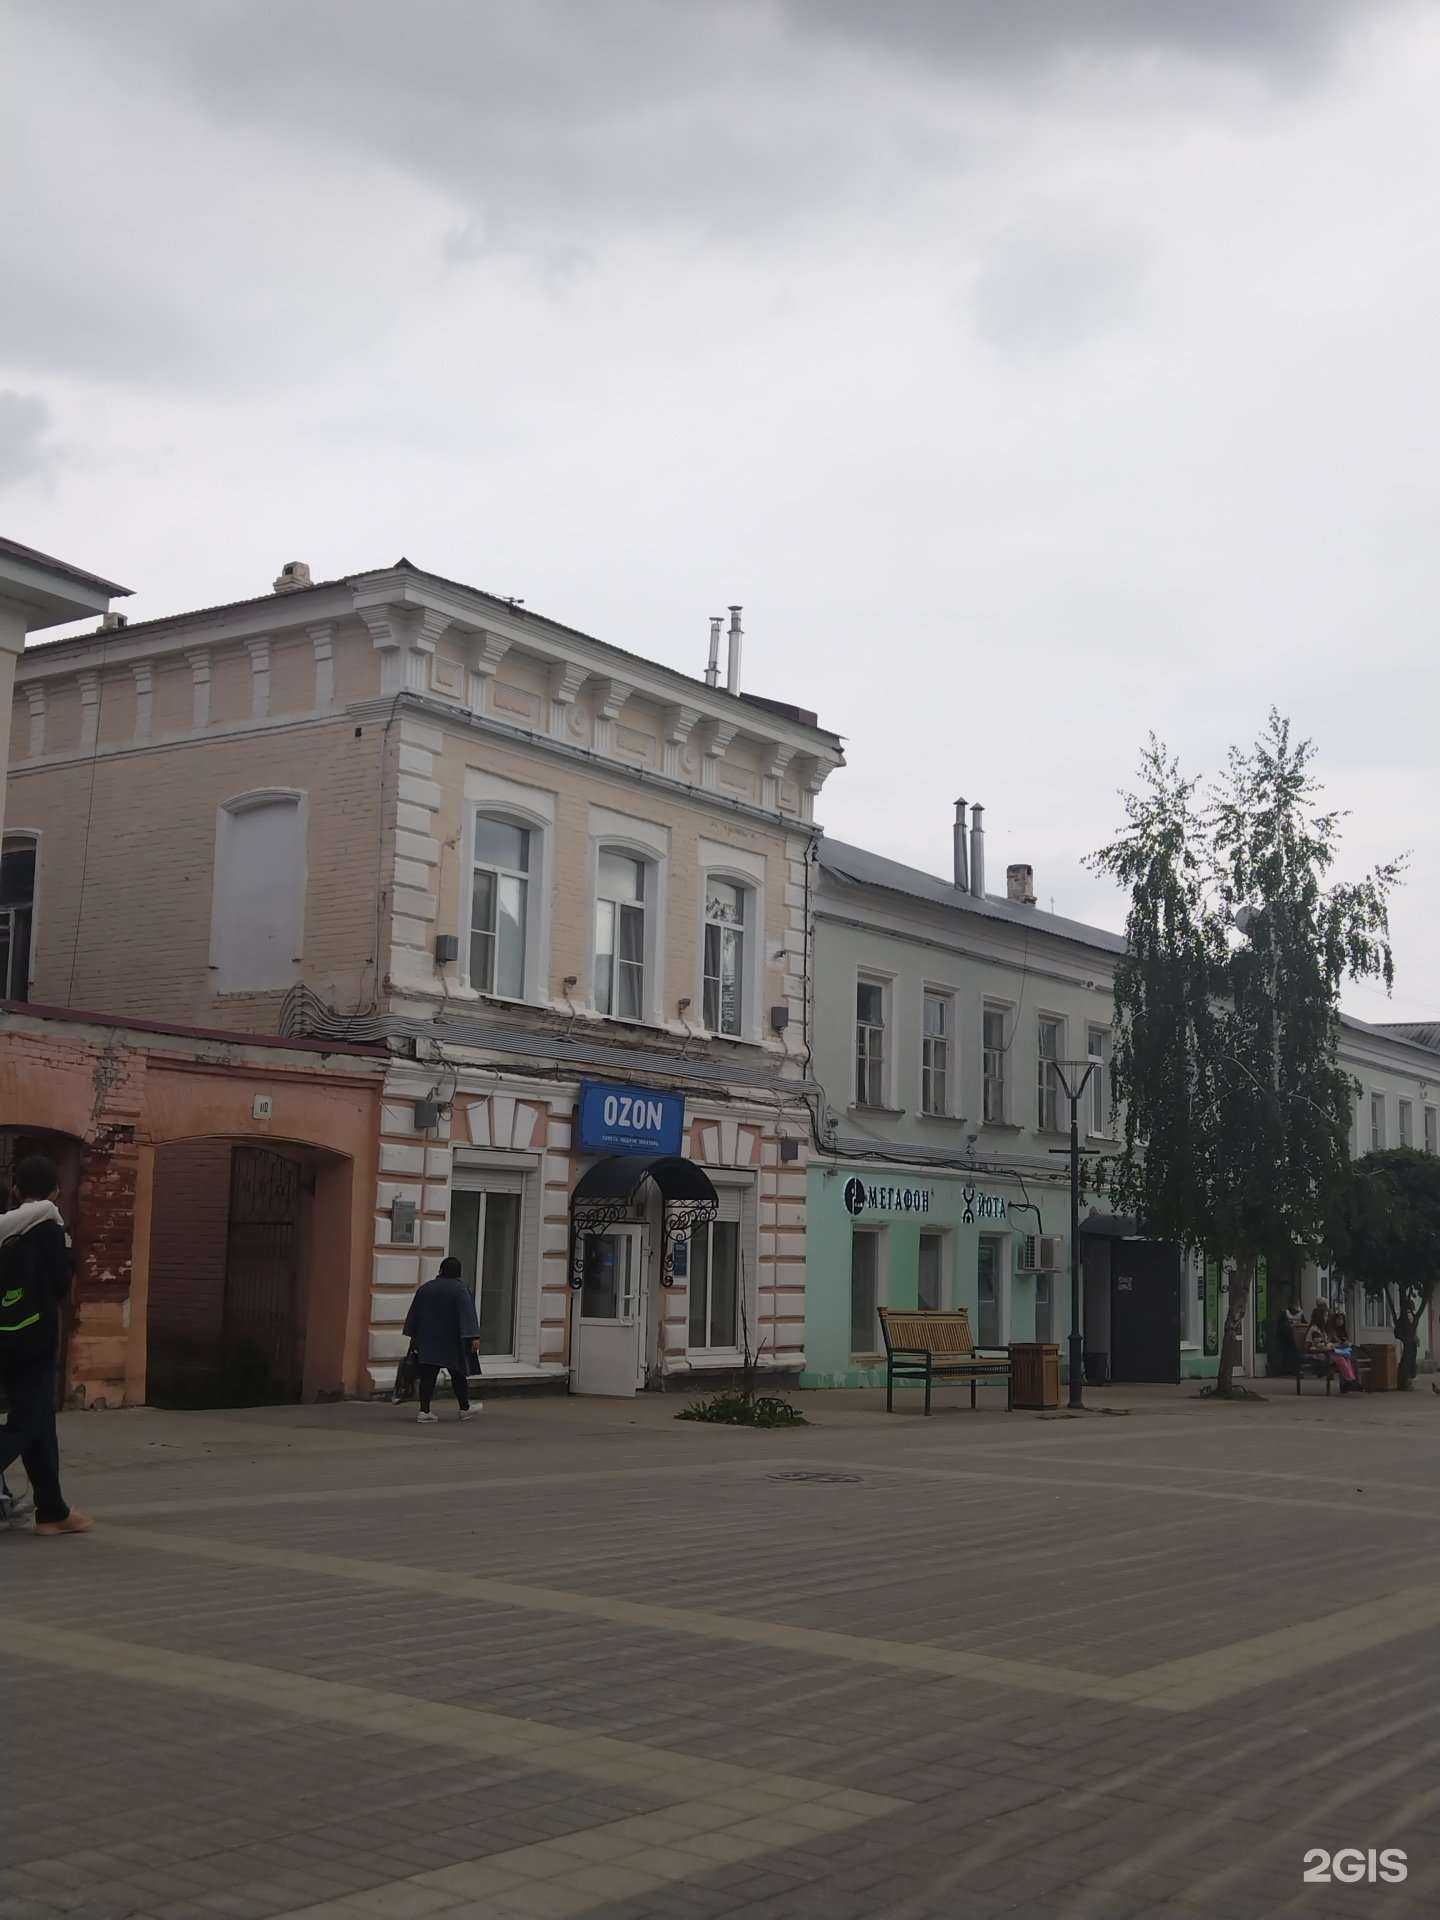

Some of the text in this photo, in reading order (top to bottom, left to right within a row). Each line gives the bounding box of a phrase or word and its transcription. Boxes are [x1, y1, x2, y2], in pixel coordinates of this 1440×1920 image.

[604, 1095, 662, 1131] OZON
[867, 1187, 929, 1214] МЕГАФОН
[977, 1192, 1007, 1219] ЙОТА
